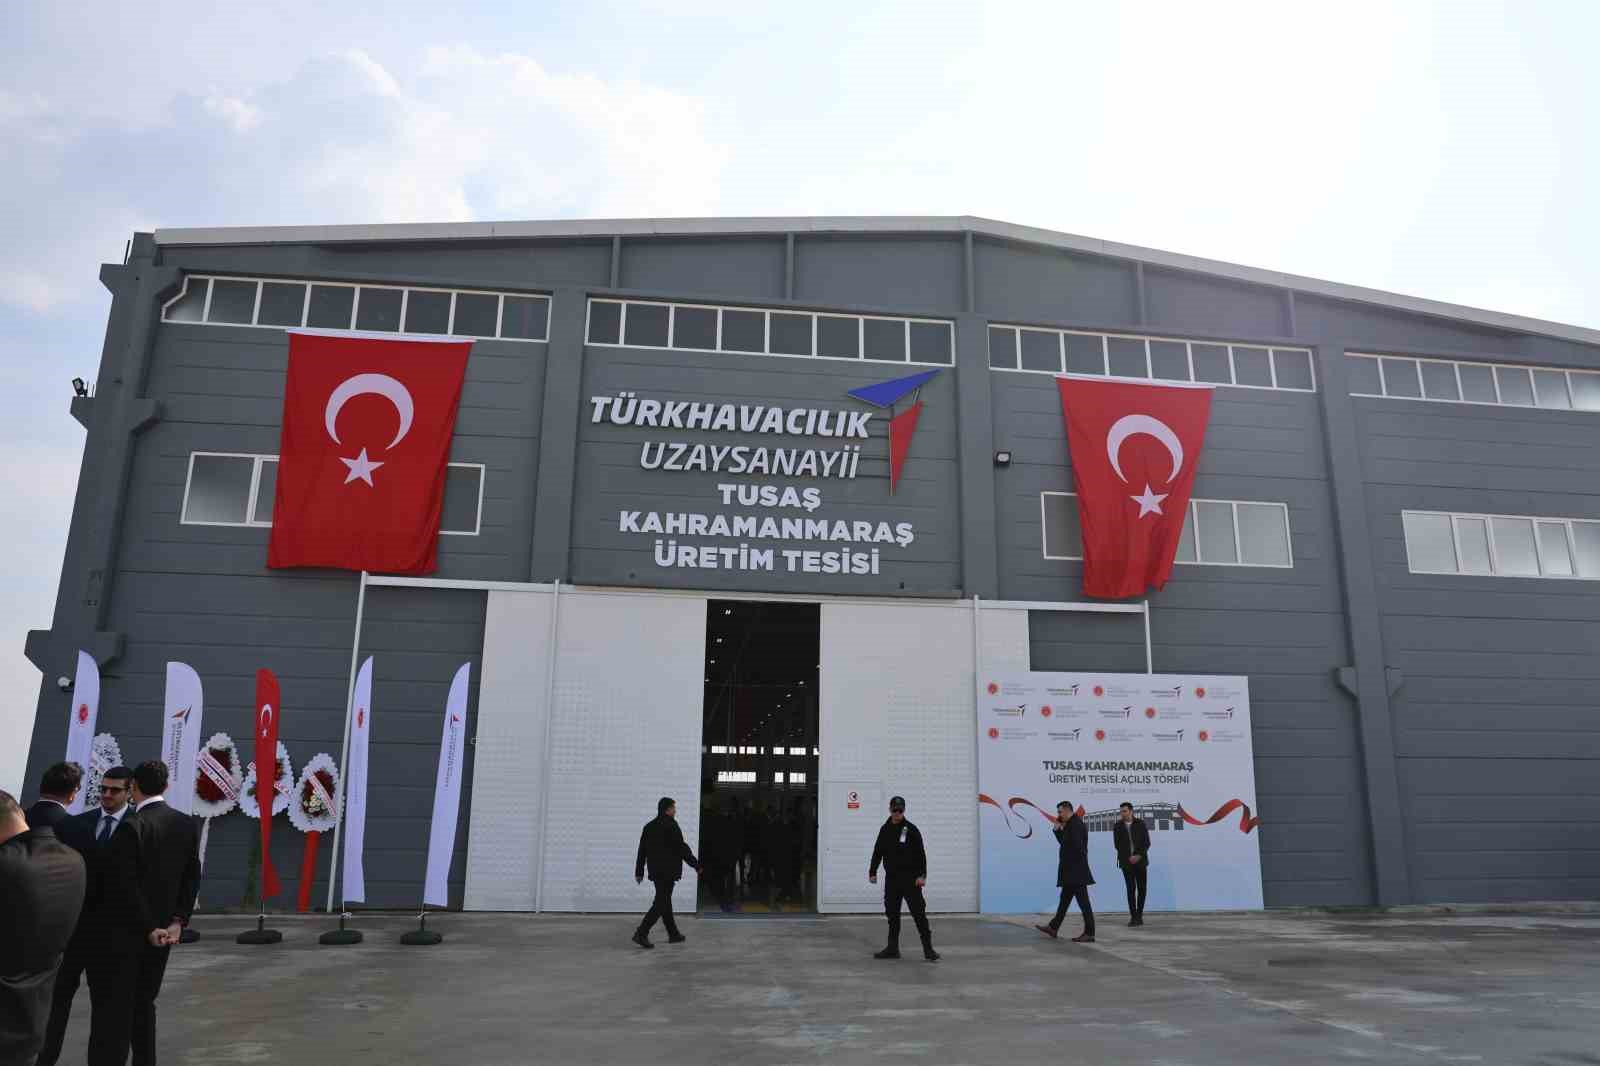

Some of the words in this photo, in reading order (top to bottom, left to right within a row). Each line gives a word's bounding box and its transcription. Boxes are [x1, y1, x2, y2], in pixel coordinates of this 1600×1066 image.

[718, 483, 821, 512] TUSAŞ
[619, 510, 914, 548] KAHRAMANMARAŞ
[655, 540, 774, 571] ÜRETİM
[783, 548, 880, 575] TESİSİ
[1042, 760, 1082, 772] TUSAŞ
[1085, 761, 1194, 773] KAHRAMANMARAŞ
